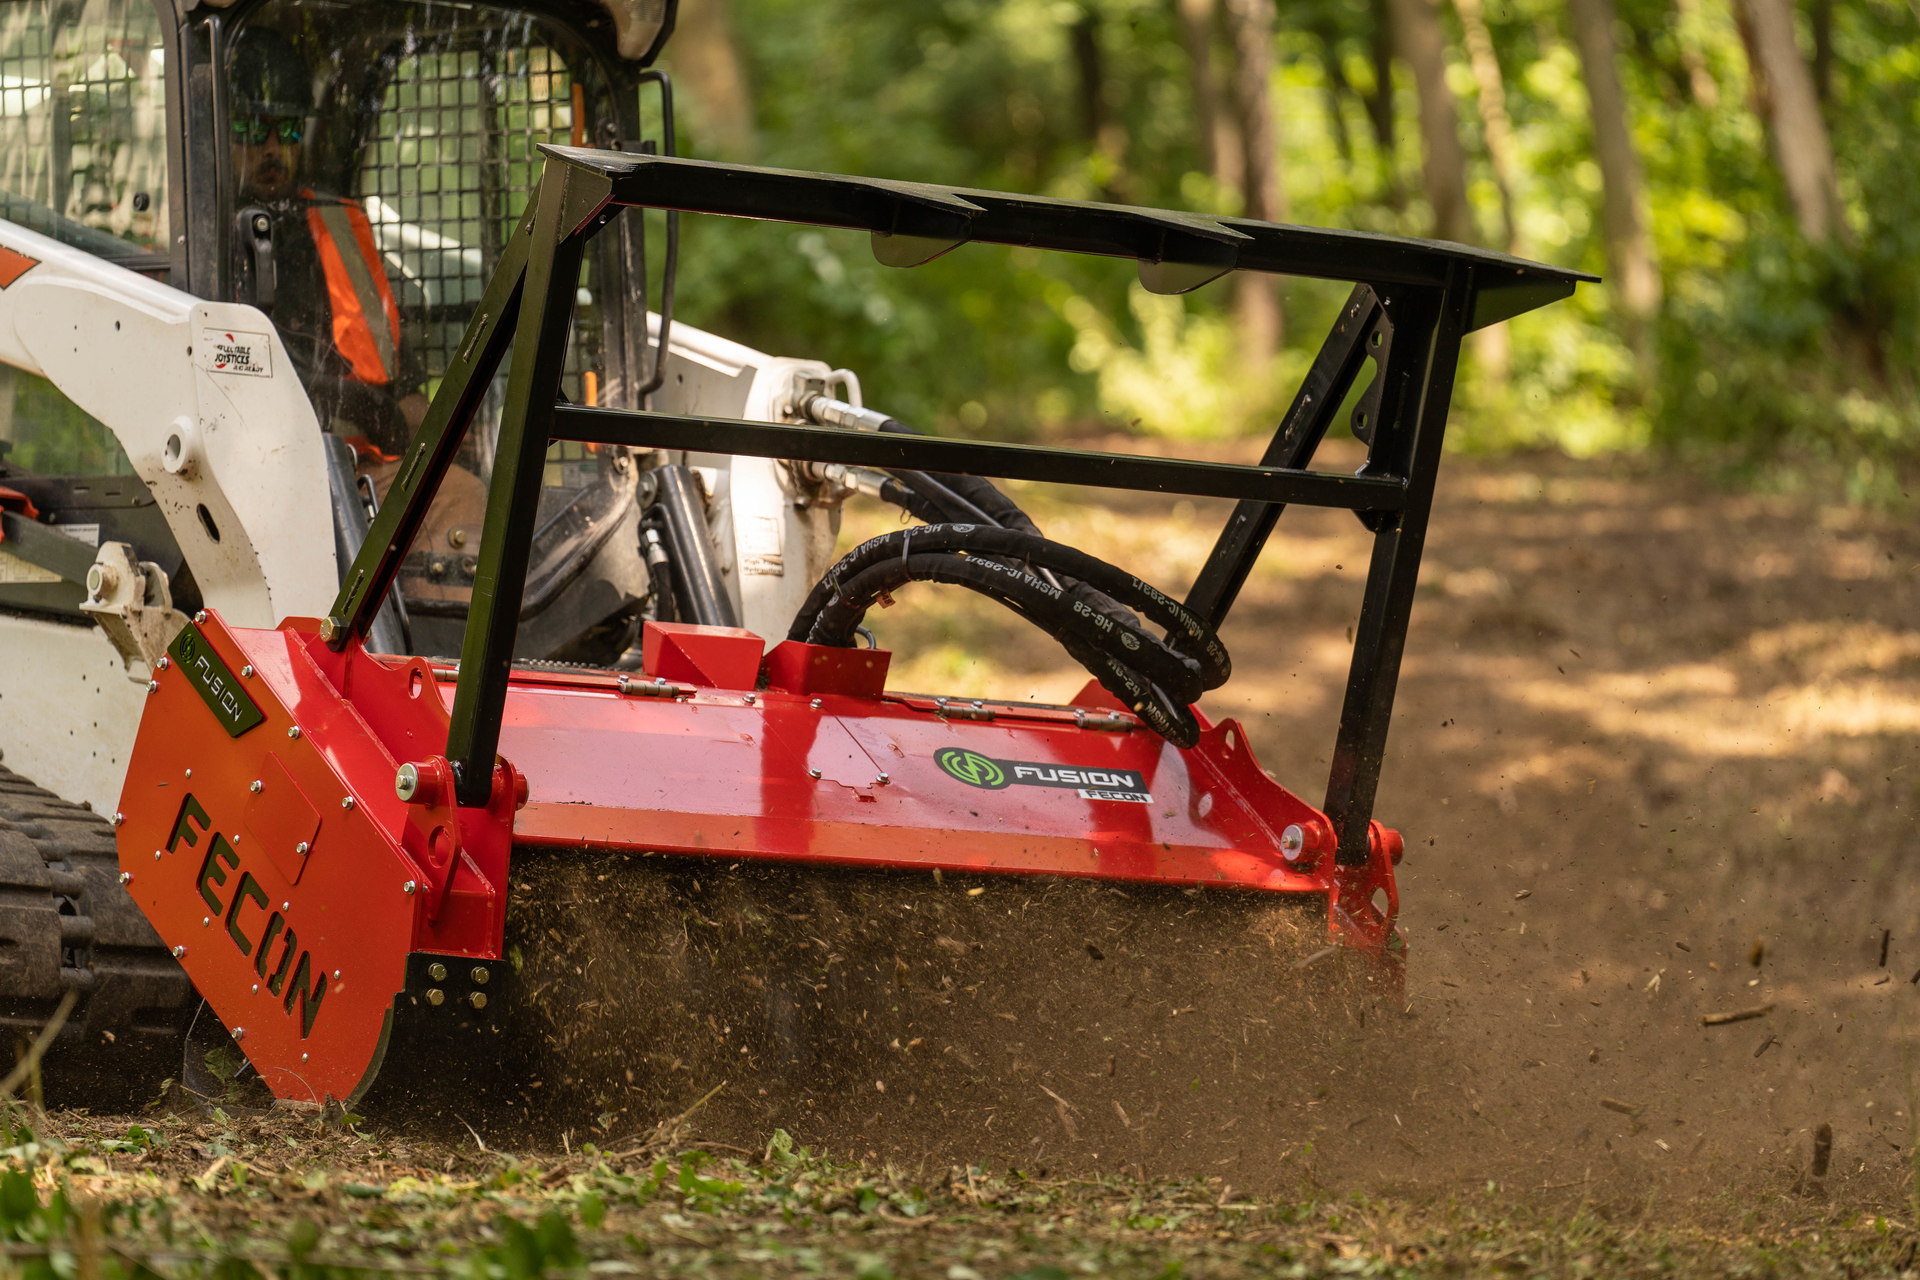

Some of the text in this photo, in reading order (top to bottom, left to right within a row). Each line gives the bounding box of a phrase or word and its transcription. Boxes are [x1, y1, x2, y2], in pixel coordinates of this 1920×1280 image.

[214, 353, 250, 365] JOYSTICKS
[860, 533, 891, 555] MSHA
[963, 554, 1023, 580] IC-293/1
[1023, 573, 1062, 600] MSHA
[1130, 575, 1179, 618] IC-293/1
[1072, 600, 1114, 633] HG-28
[1179, 609, 1204, 641] MSHA
[192, 653, 244, 724] FUSION
[1145, 701, 1169, 732] MSHA
[1013, 765, 1136, 788] FUSION
[1086, 790, 1148, 803] FECON
[164, 791, 328, 1041] FECON
